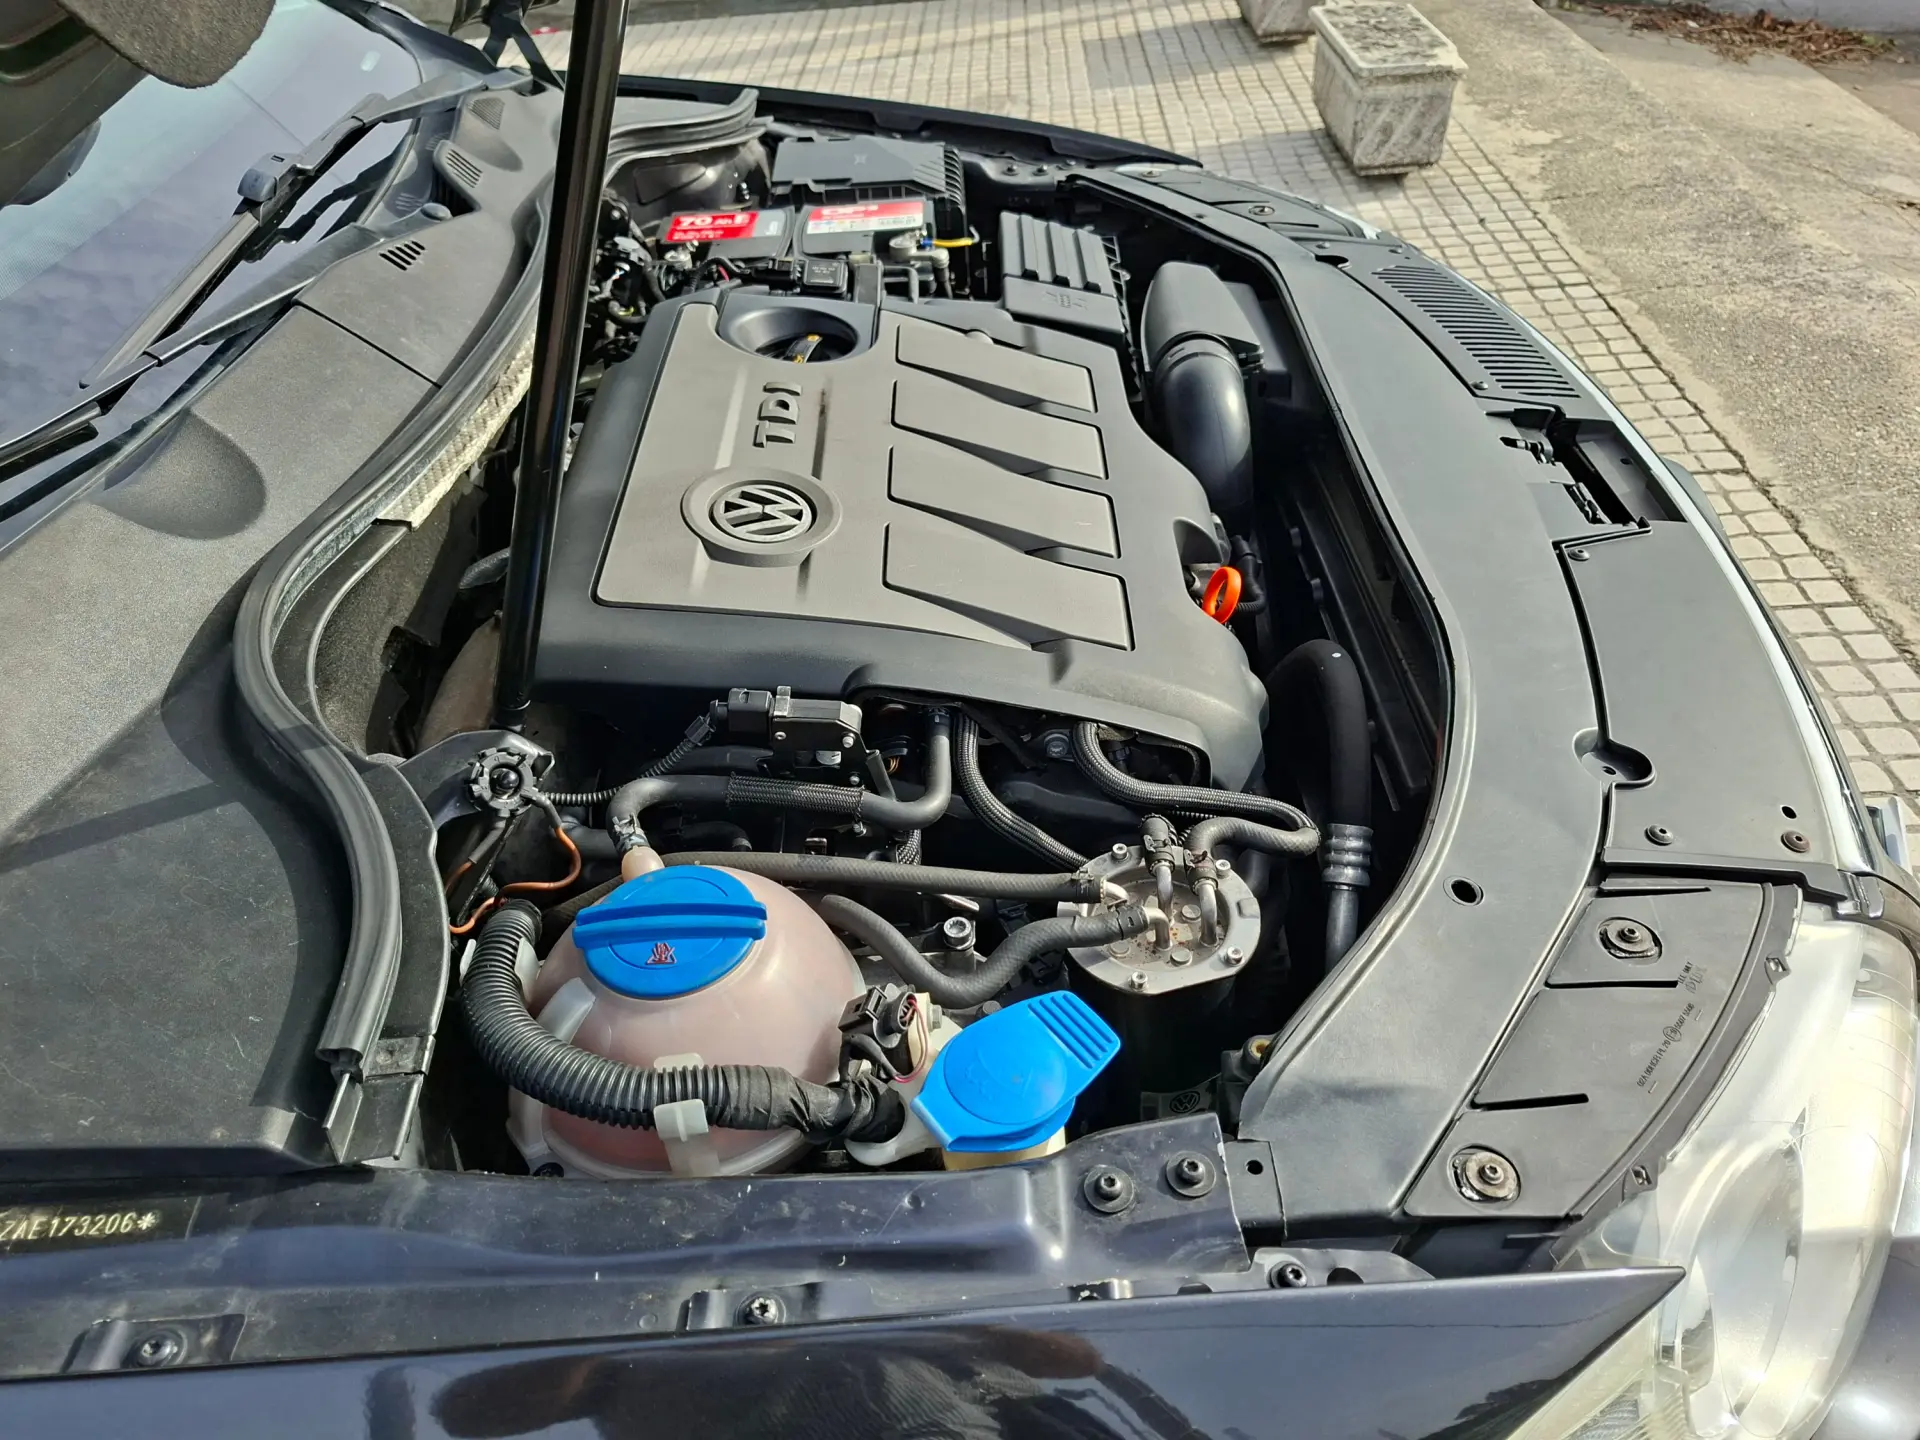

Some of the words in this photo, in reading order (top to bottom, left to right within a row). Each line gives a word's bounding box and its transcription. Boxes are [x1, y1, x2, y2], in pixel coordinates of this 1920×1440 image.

[678, 216, 714, 227] 70
[753, 381, 802, 448] TDI
[711, 484, 813, 544] VW
